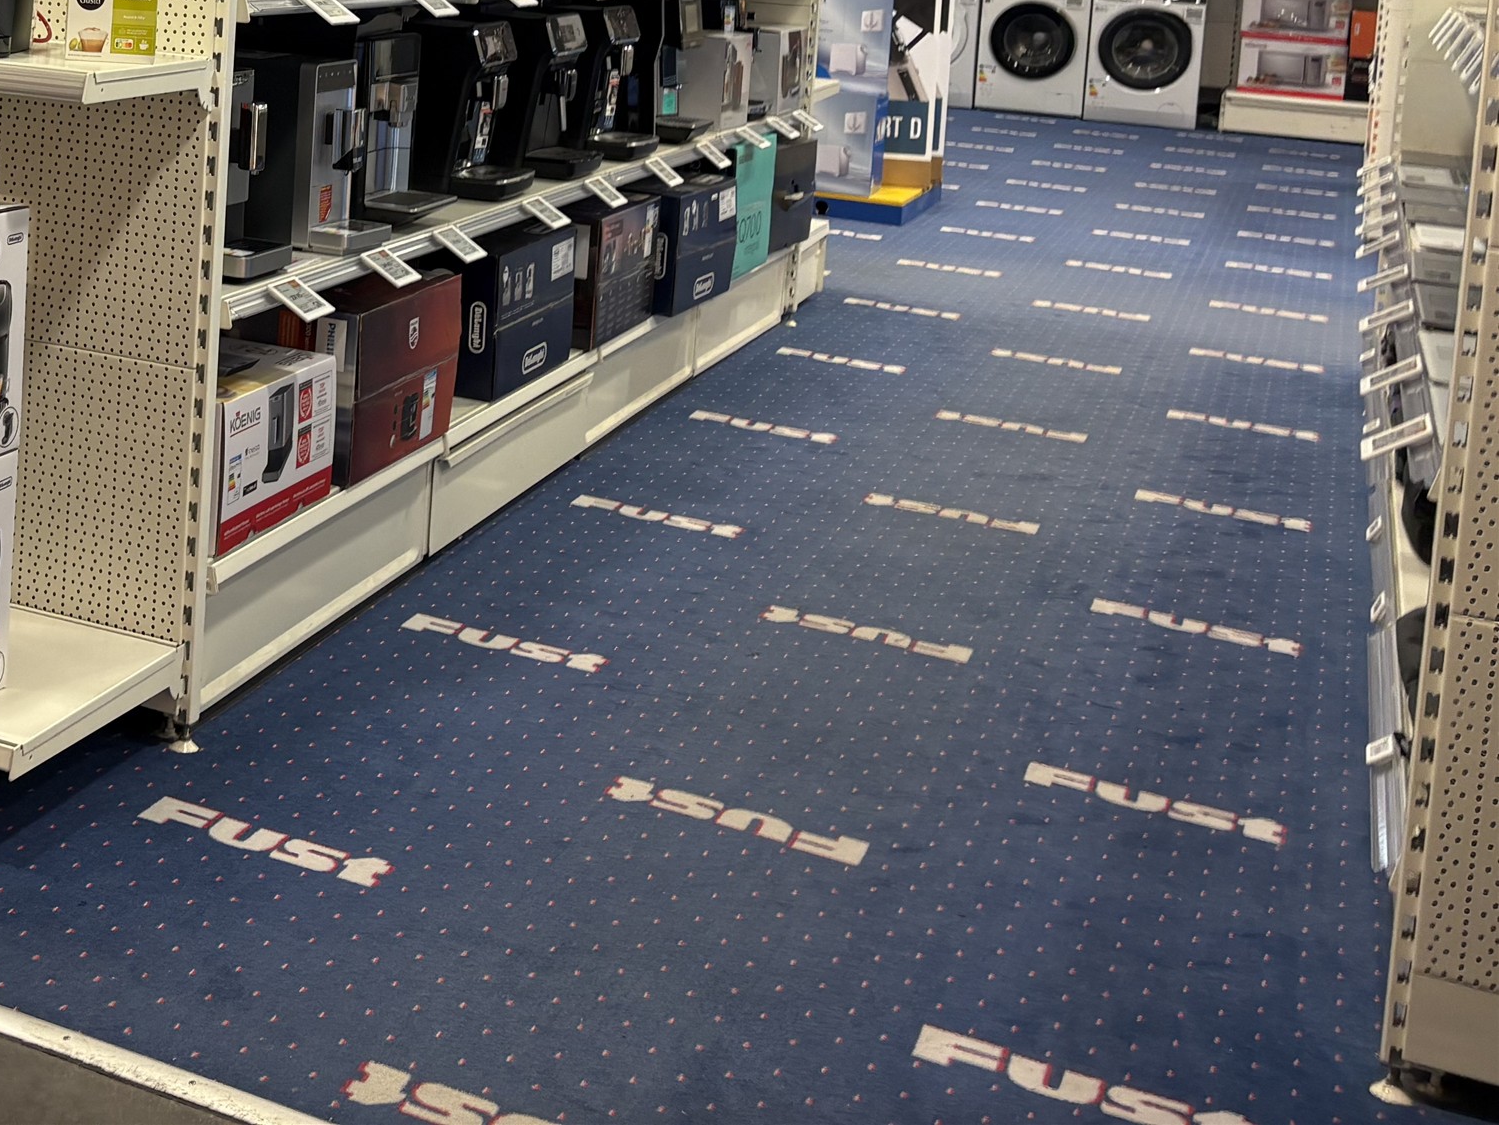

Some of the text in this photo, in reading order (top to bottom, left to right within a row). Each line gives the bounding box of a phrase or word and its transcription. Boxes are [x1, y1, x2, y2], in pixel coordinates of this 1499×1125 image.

[910, 116, 922, 140] D
[737, 210, 762, 245] Q700
[326, 322, 336, 355] PHILI
